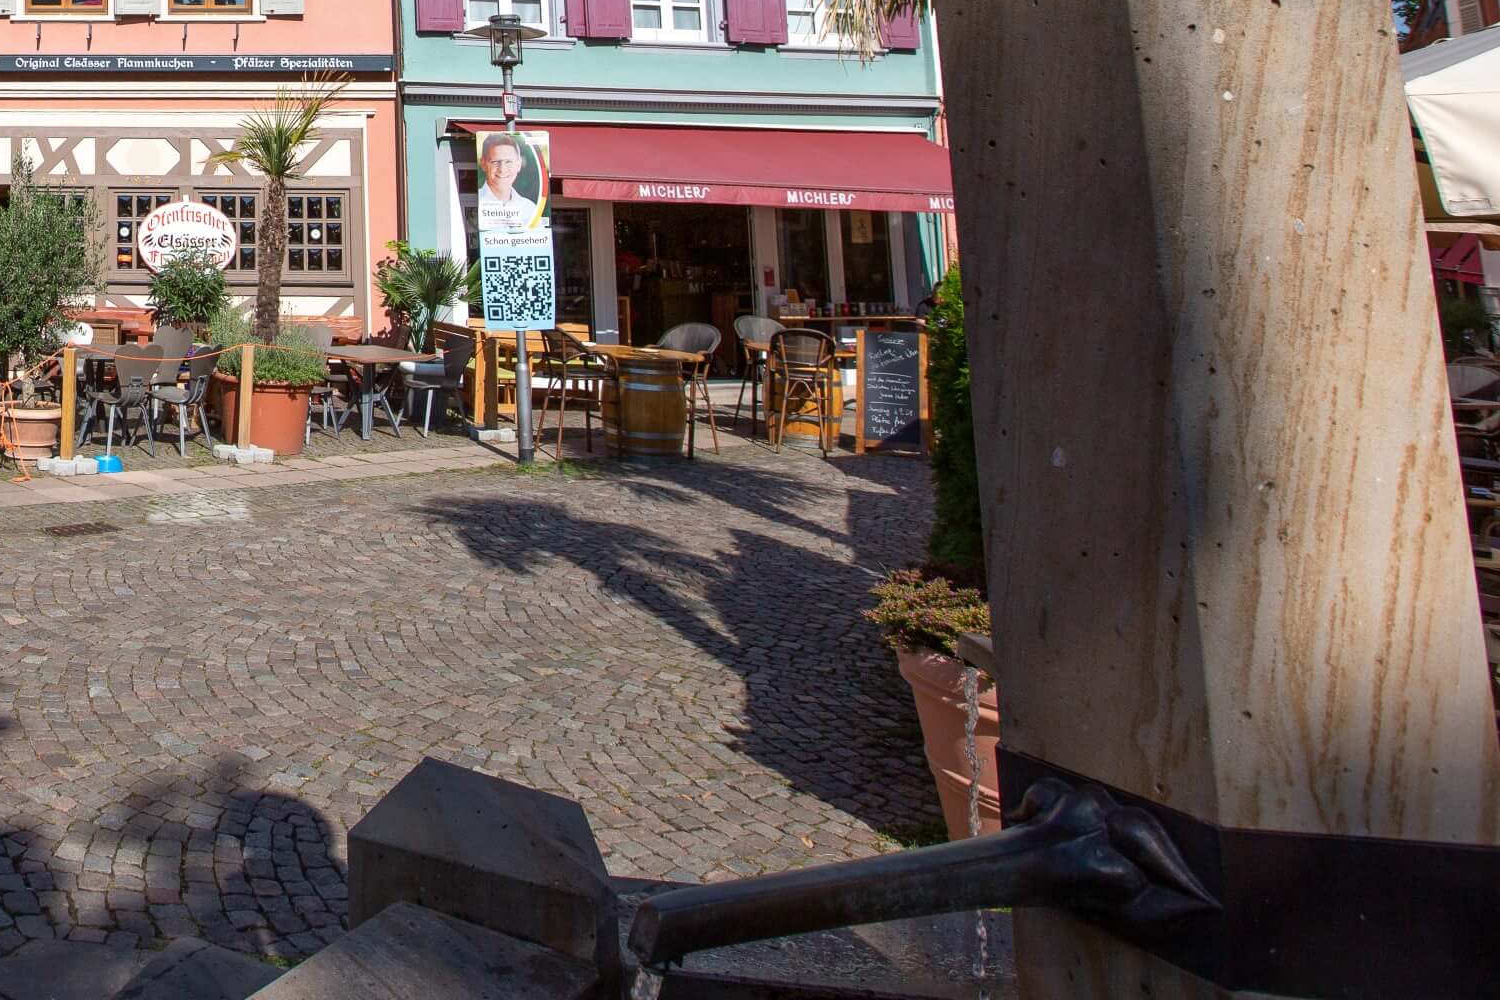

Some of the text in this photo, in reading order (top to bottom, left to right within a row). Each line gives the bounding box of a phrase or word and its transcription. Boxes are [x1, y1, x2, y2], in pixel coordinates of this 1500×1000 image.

[15, 57, 59, 70] Original
[64, 56, 111, 68] Elsässer
[117, 57, 194, 70] Flammkuchen
[232, 57, 275, 70] Pfälzer
[280, 56, 354, 70] Spezialitäten
[638, 184, 711, 199] MICHLERS
[786, 190, 857, 206] MICHLERS
[147, 204, 227, 232] Ofenfrischer
[157, 233, 217, 249] Elsässer
[484, 236, 548, 247] Schon gesehen?
